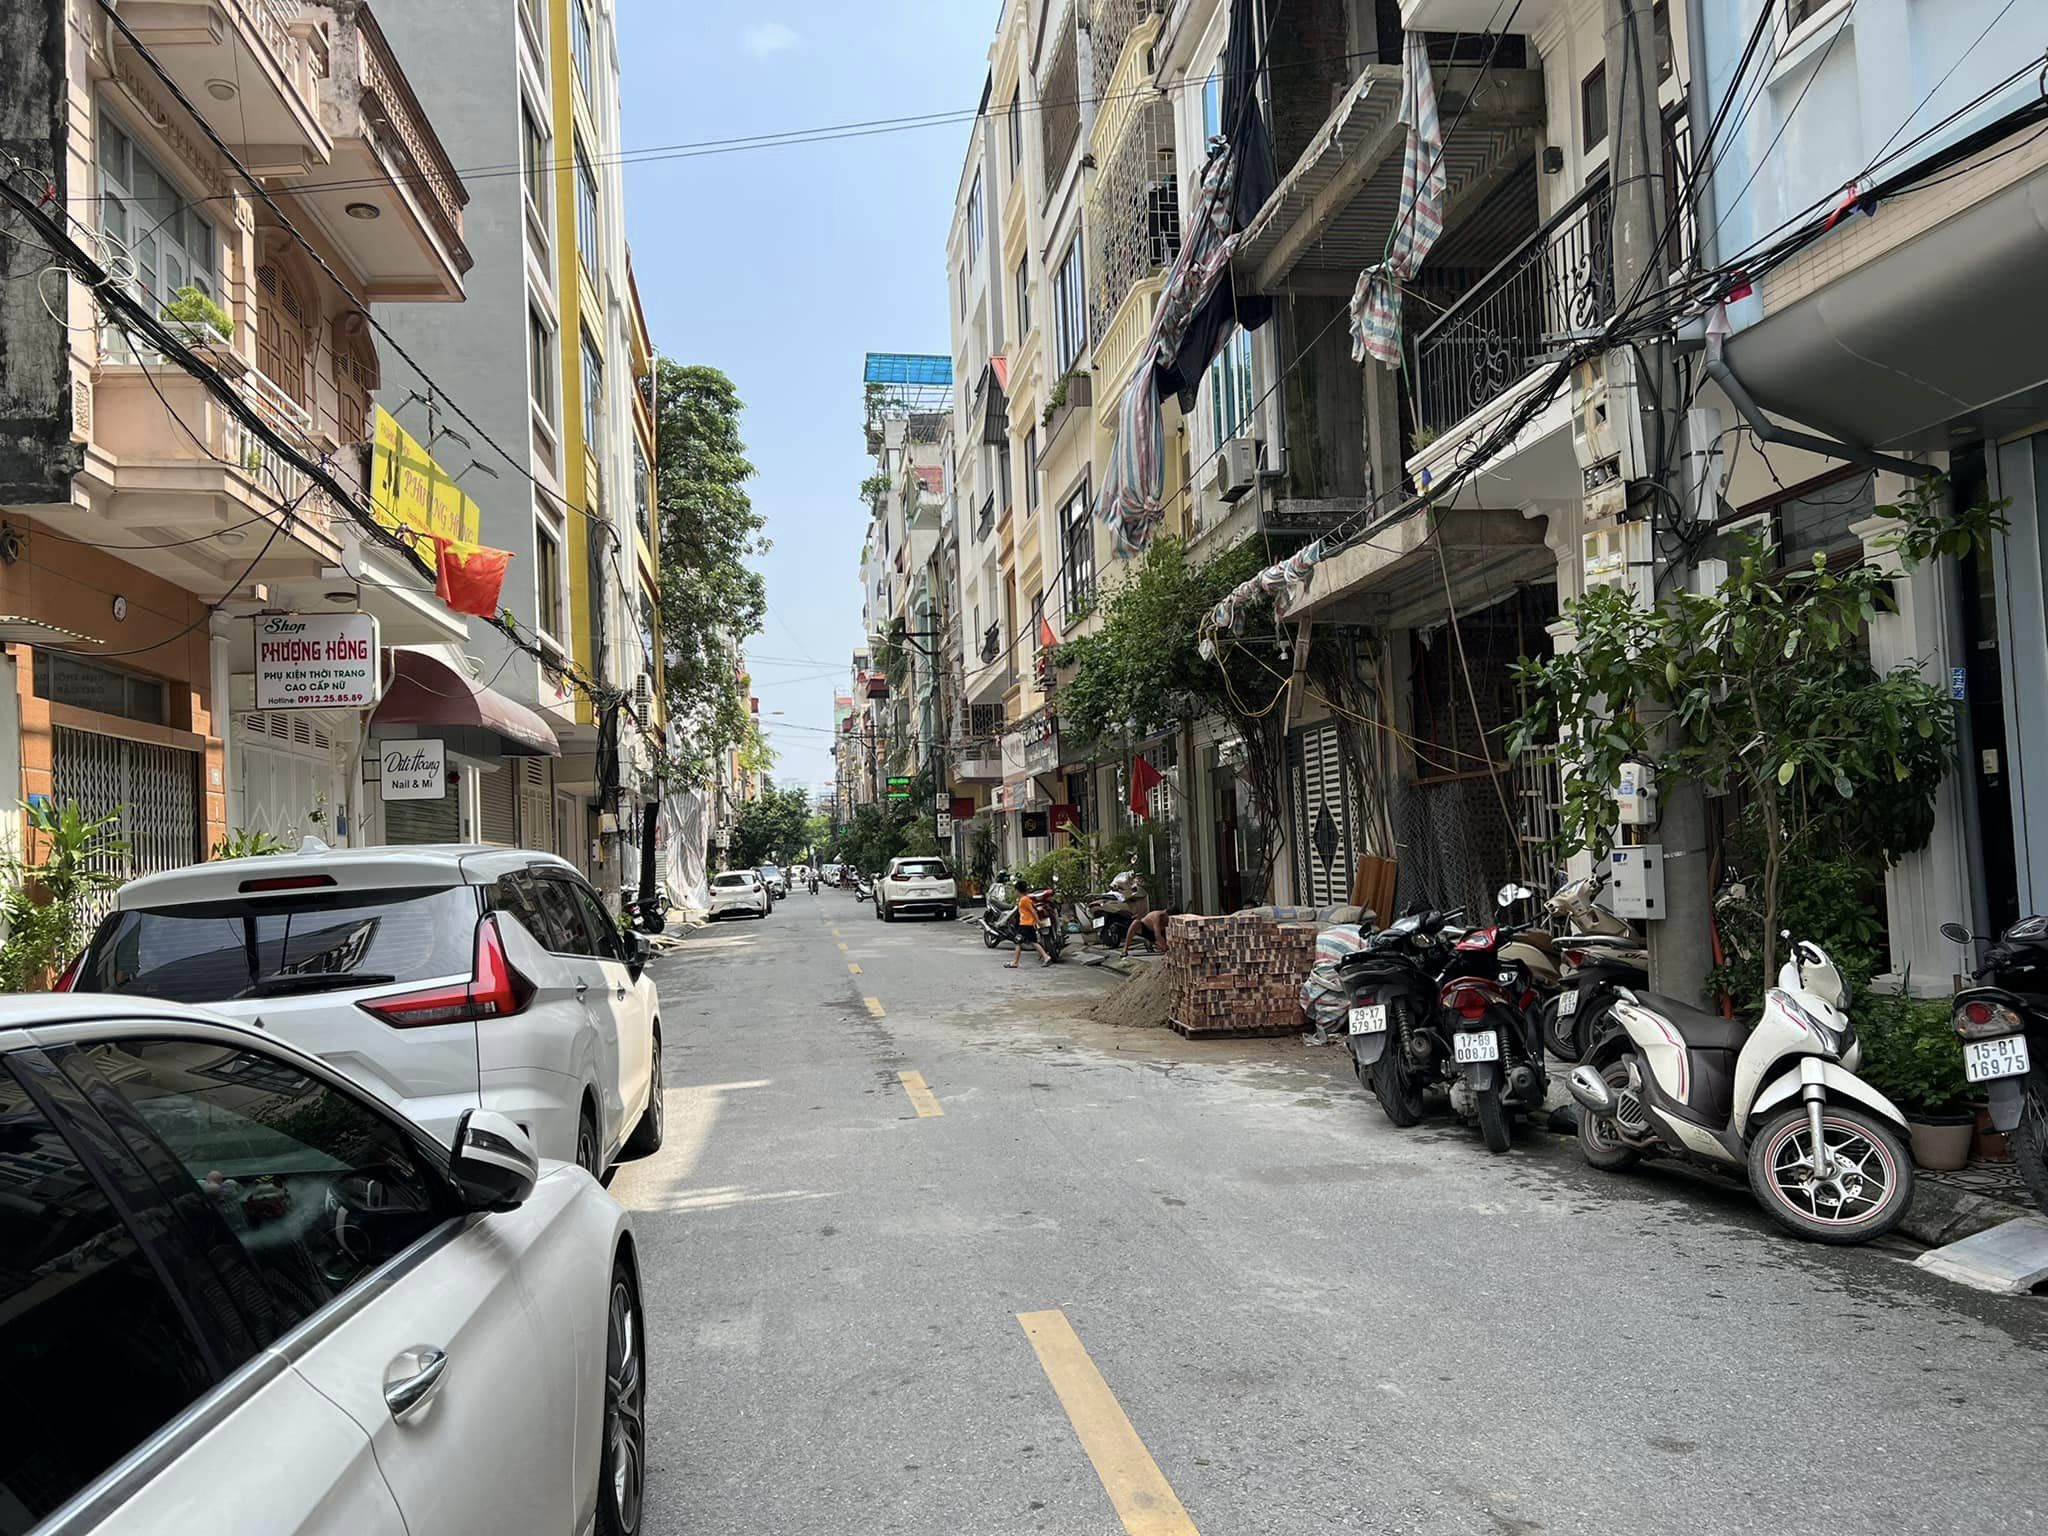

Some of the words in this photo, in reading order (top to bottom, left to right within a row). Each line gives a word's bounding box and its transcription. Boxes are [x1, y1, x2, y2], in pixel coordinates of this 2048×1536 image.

[264, 618, 306, 634] Shop
[261, 639, 321, 666] PHƯỢNG
[325, 632, 368, 660] HỒNG
[264, 672, 283, 682] PHỤ
[286, 669, 307, 681] KIỆN
[309, 669, 331, 679] THỜI
[334, 669, 366, 678] TRANG
[284, 684, 307, 692] CAO
[309, 680, 330, 690] CẤP
[392, 780, 410, 789] Nail
[412, 780, 419, 789] &
[1973, 1039, 2016, 1061] 15-B1
[1971, 1055, 2025, 1078] 169.75
